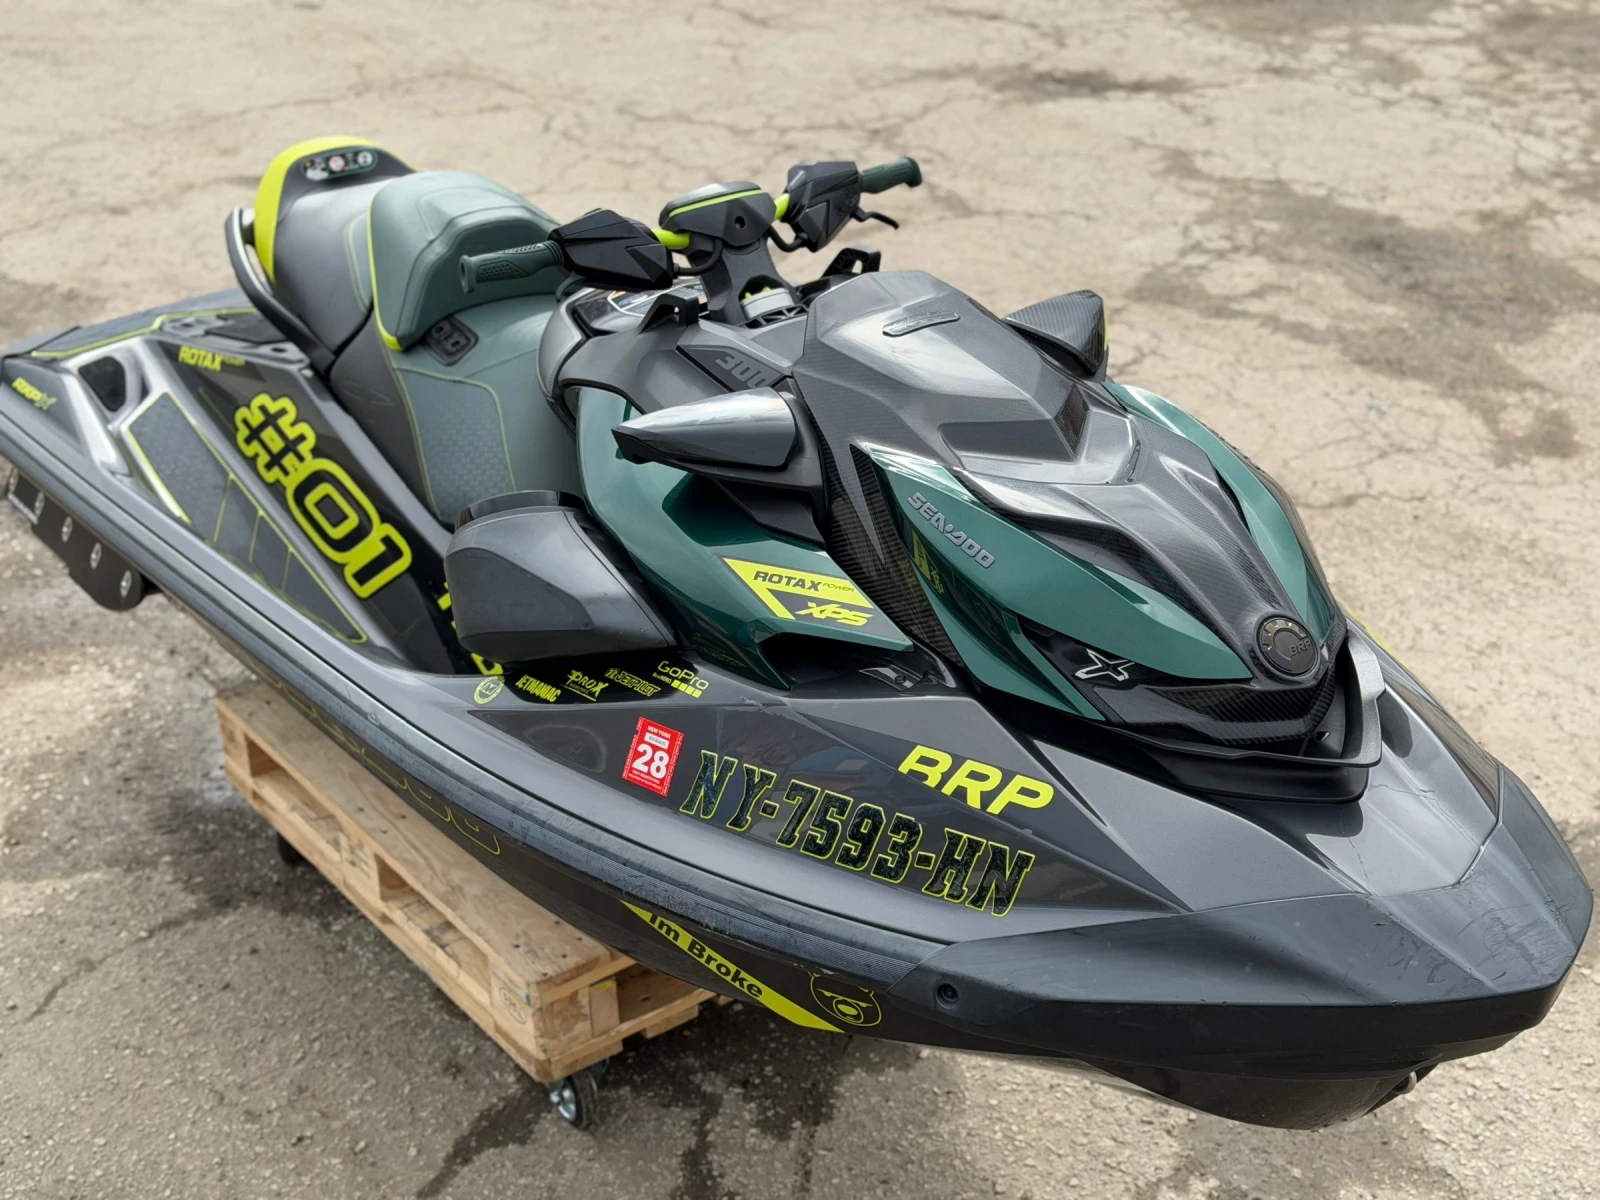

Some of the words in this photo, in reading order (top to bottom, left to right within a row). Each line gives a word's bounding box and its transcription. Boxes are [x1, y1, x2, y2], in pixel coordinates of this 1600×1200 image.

[178, 345, 222, 371] ROTAX
[753, 570, 822, 592] ROTAX
[821, 581, 855, 593] POWER
[795, 602, 874, 626] XPS
[1288, 638, 1311, 657] BRP
[657, 660, 709, 690] GoPro
[647, 725, 659, 735] NEW
[658, 729, 672, 739] YORK
[632, 743, 670, 779] 28
[686, 938, 763, 998] Broke
